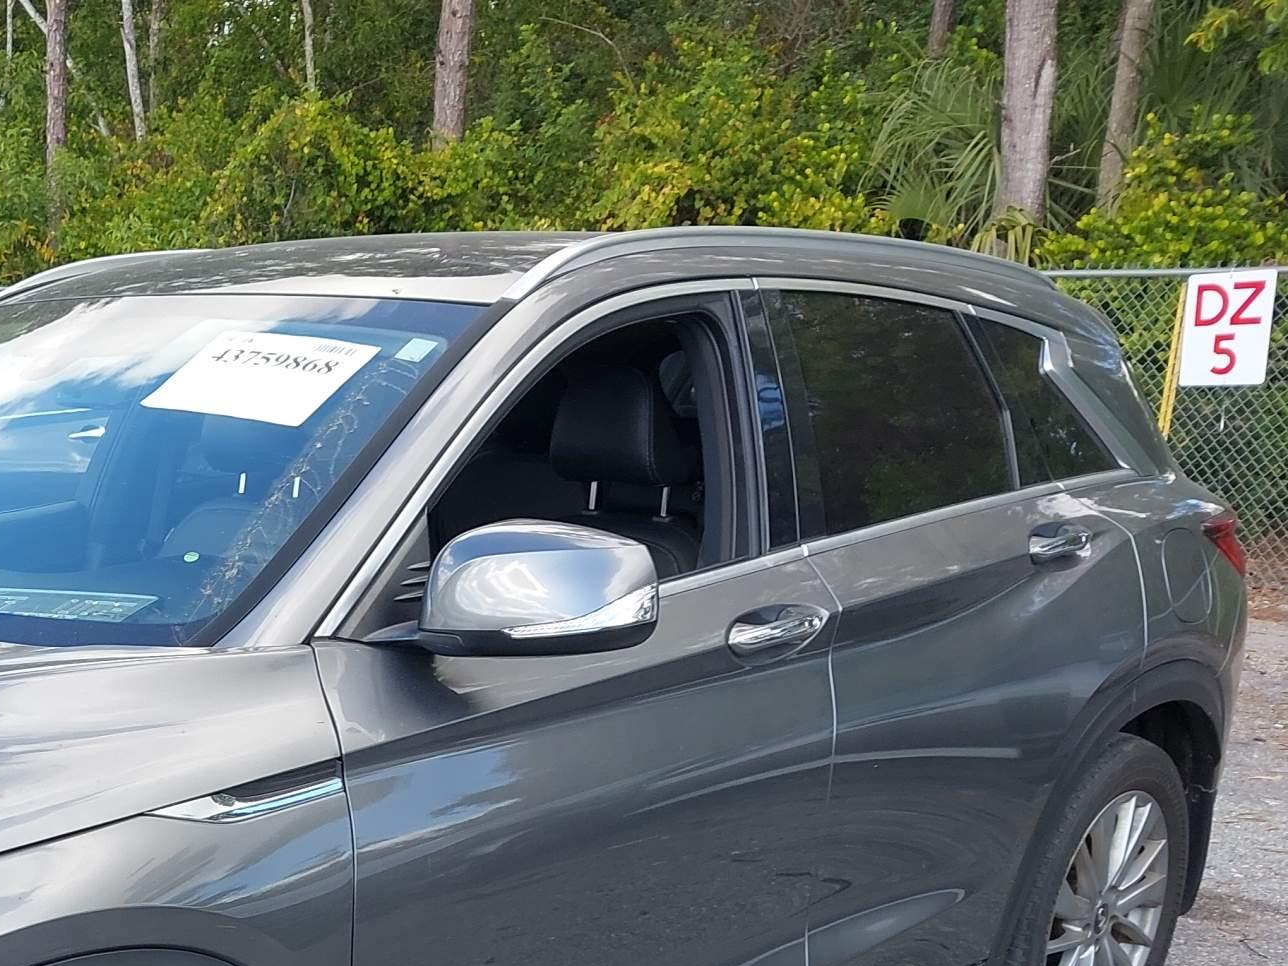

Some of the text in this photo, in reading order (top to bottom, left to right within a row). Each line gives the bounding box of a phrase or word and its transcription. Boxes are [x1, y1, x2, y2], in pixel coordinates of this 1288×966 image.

[1194, 280, 1266, 327] DZ
[212, 348, 340, 375] 43759868
[1210, 333, 1237, 375] 5
